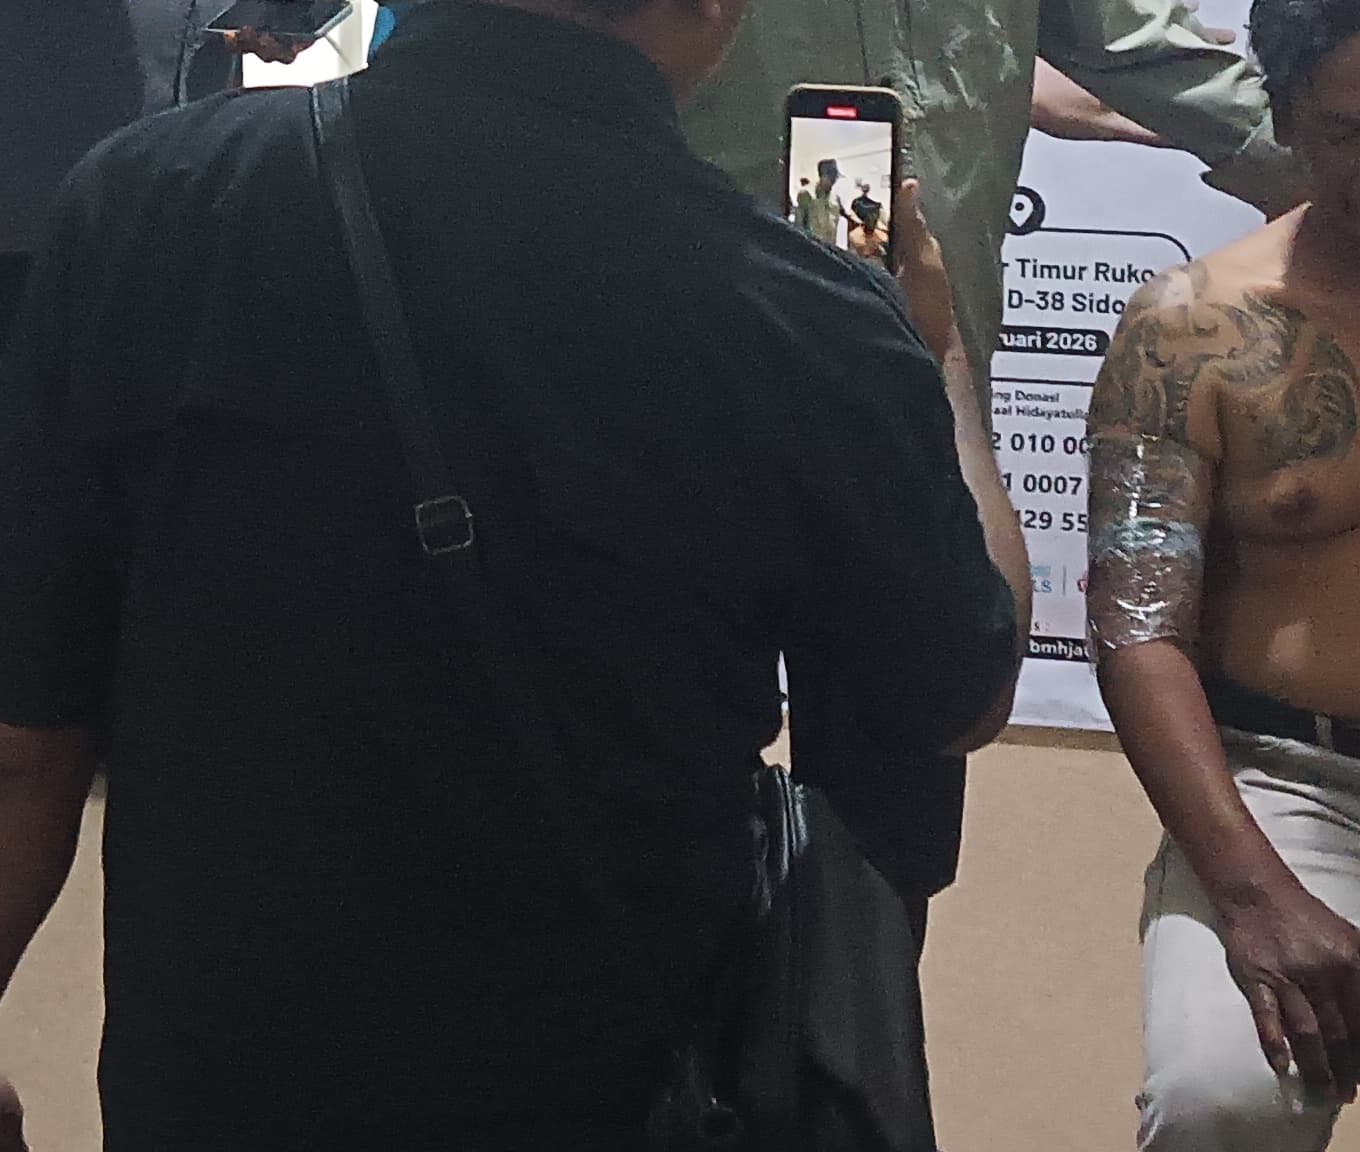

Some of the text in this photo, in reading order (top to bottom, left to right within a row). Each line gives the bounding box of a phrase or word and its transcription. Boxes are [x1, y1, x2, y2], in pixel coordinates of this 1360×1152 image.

[1016, 258, 1154, 284] Timur Ruko
[1008, 289, 1126, 315] D-38 Sido
[999, 330, 1098, 351] uari 2026
[992, 391, 1011, 402] ng
[993, 406, 1012, 416] aal
[991, 432, 1001, 450] 2
[1011, 433, 1055, 453] 010
[1001, 473, 1082, 495] 1 0007
[1015, 510, 1088, 533] 29 55
